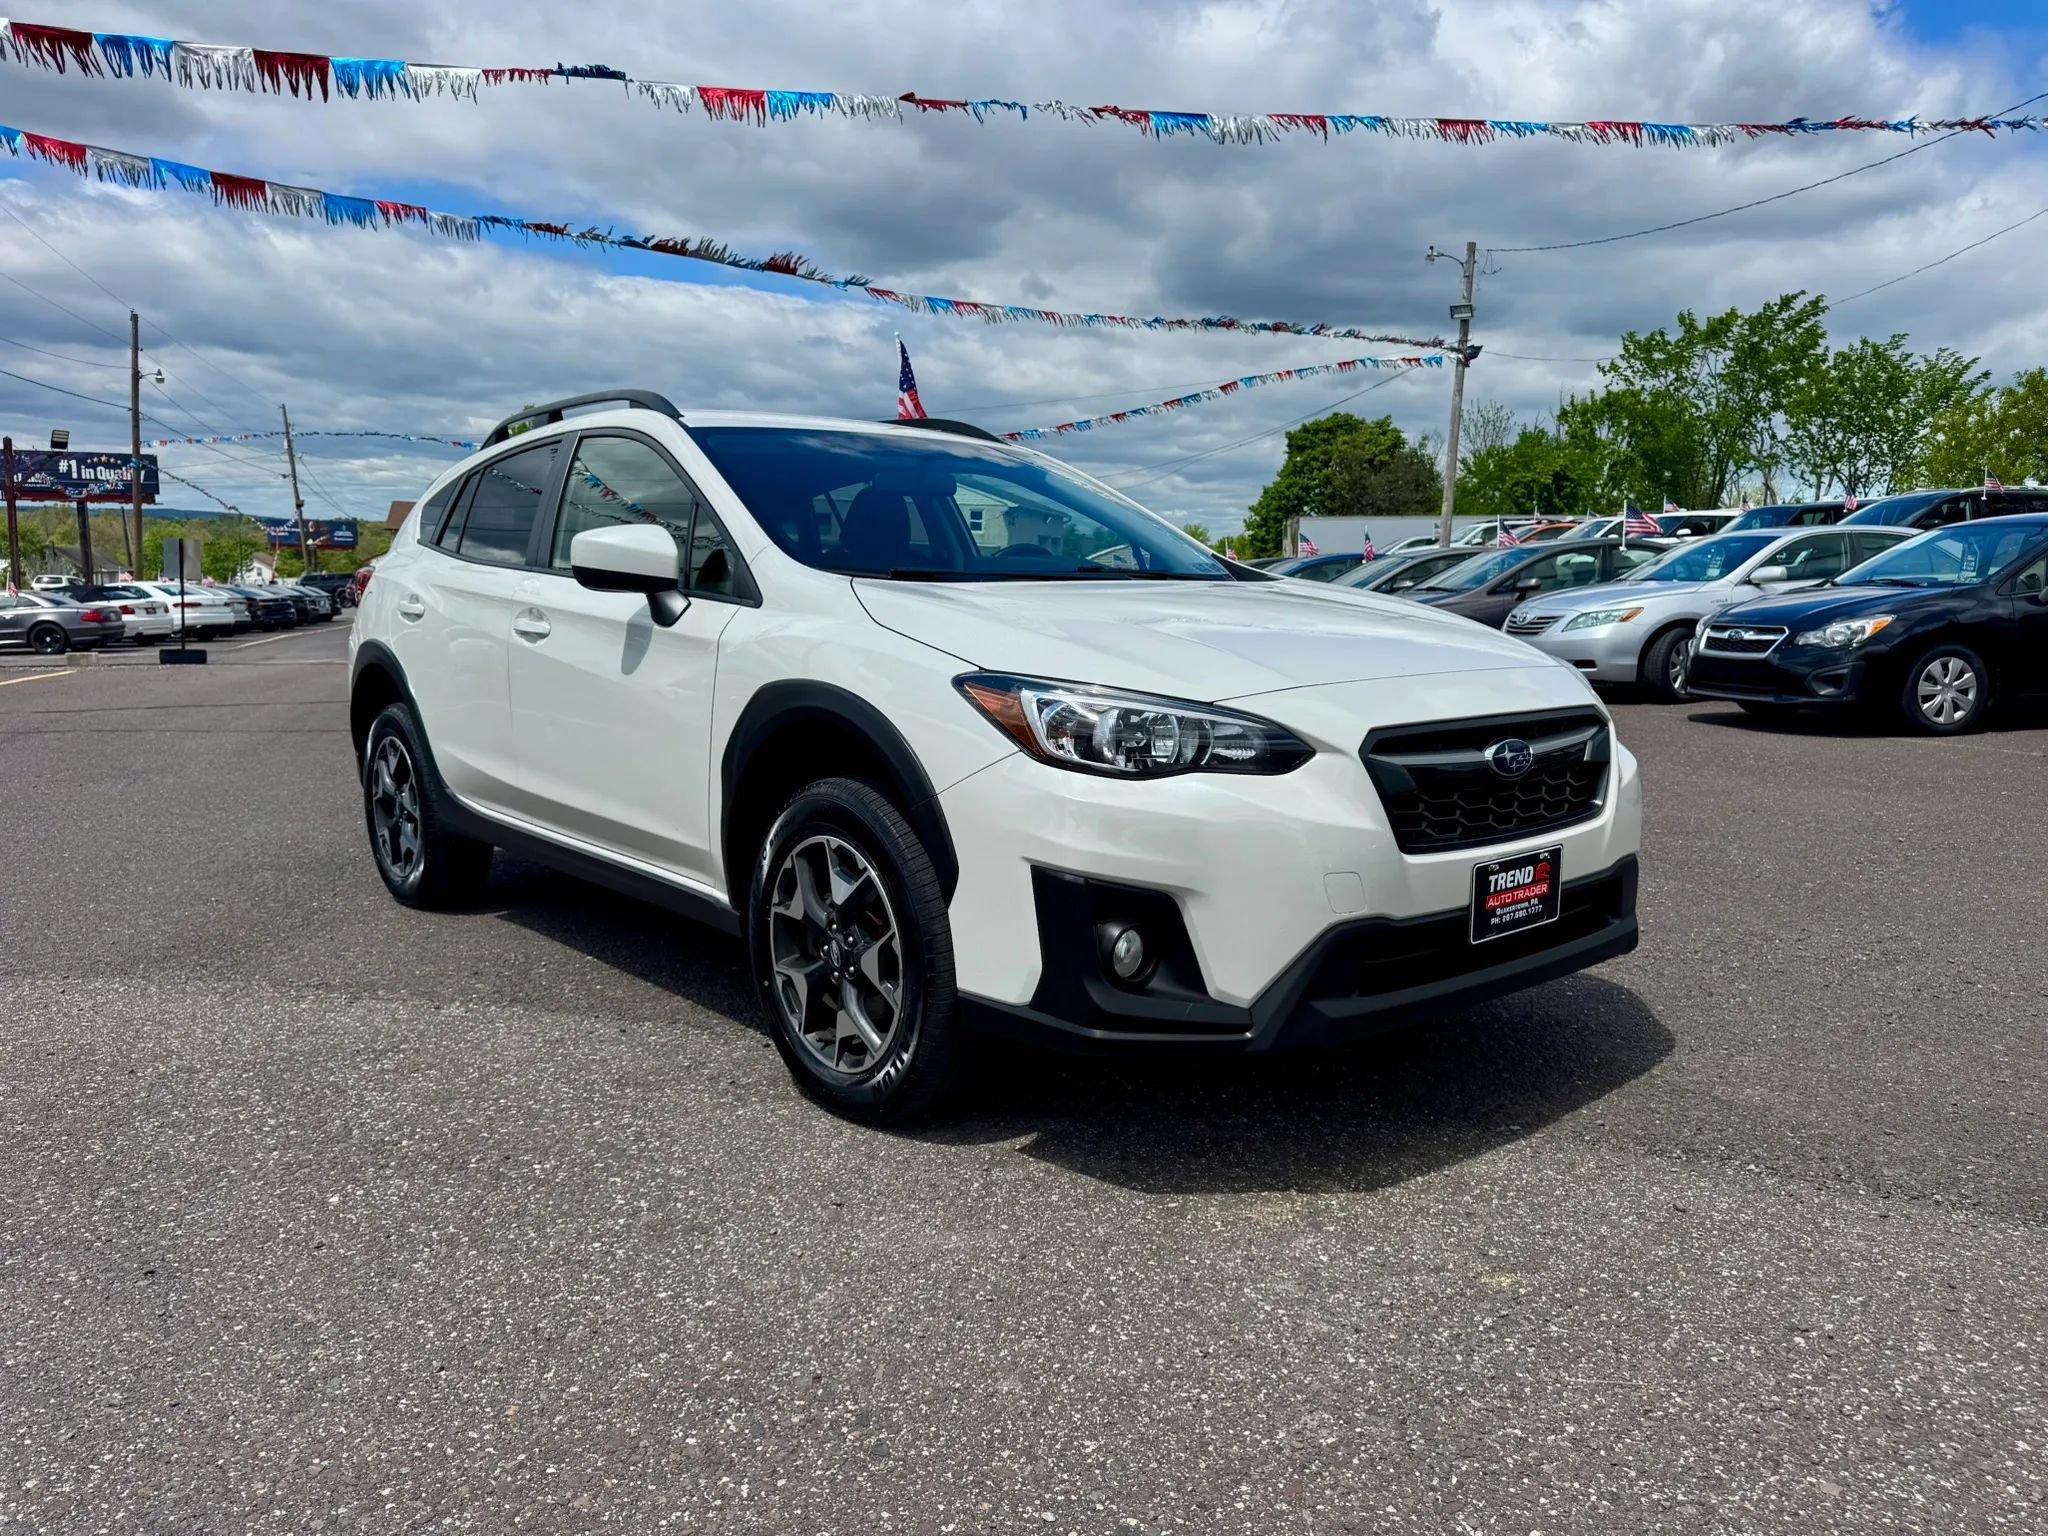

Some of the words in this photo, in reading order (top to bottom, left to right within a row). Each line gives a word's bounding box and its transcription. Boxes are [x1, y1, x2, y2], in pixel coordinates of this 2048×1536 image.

[58, 459, 78, 479] #1
[81, 465, 95, 480] in
[96, 466, 145, 484] Quali
[1489, 866, 1534, 892] TREND
[1487, 893, 1512, 907] AUTO
[1513, 883, 1548, 900] TRADER
